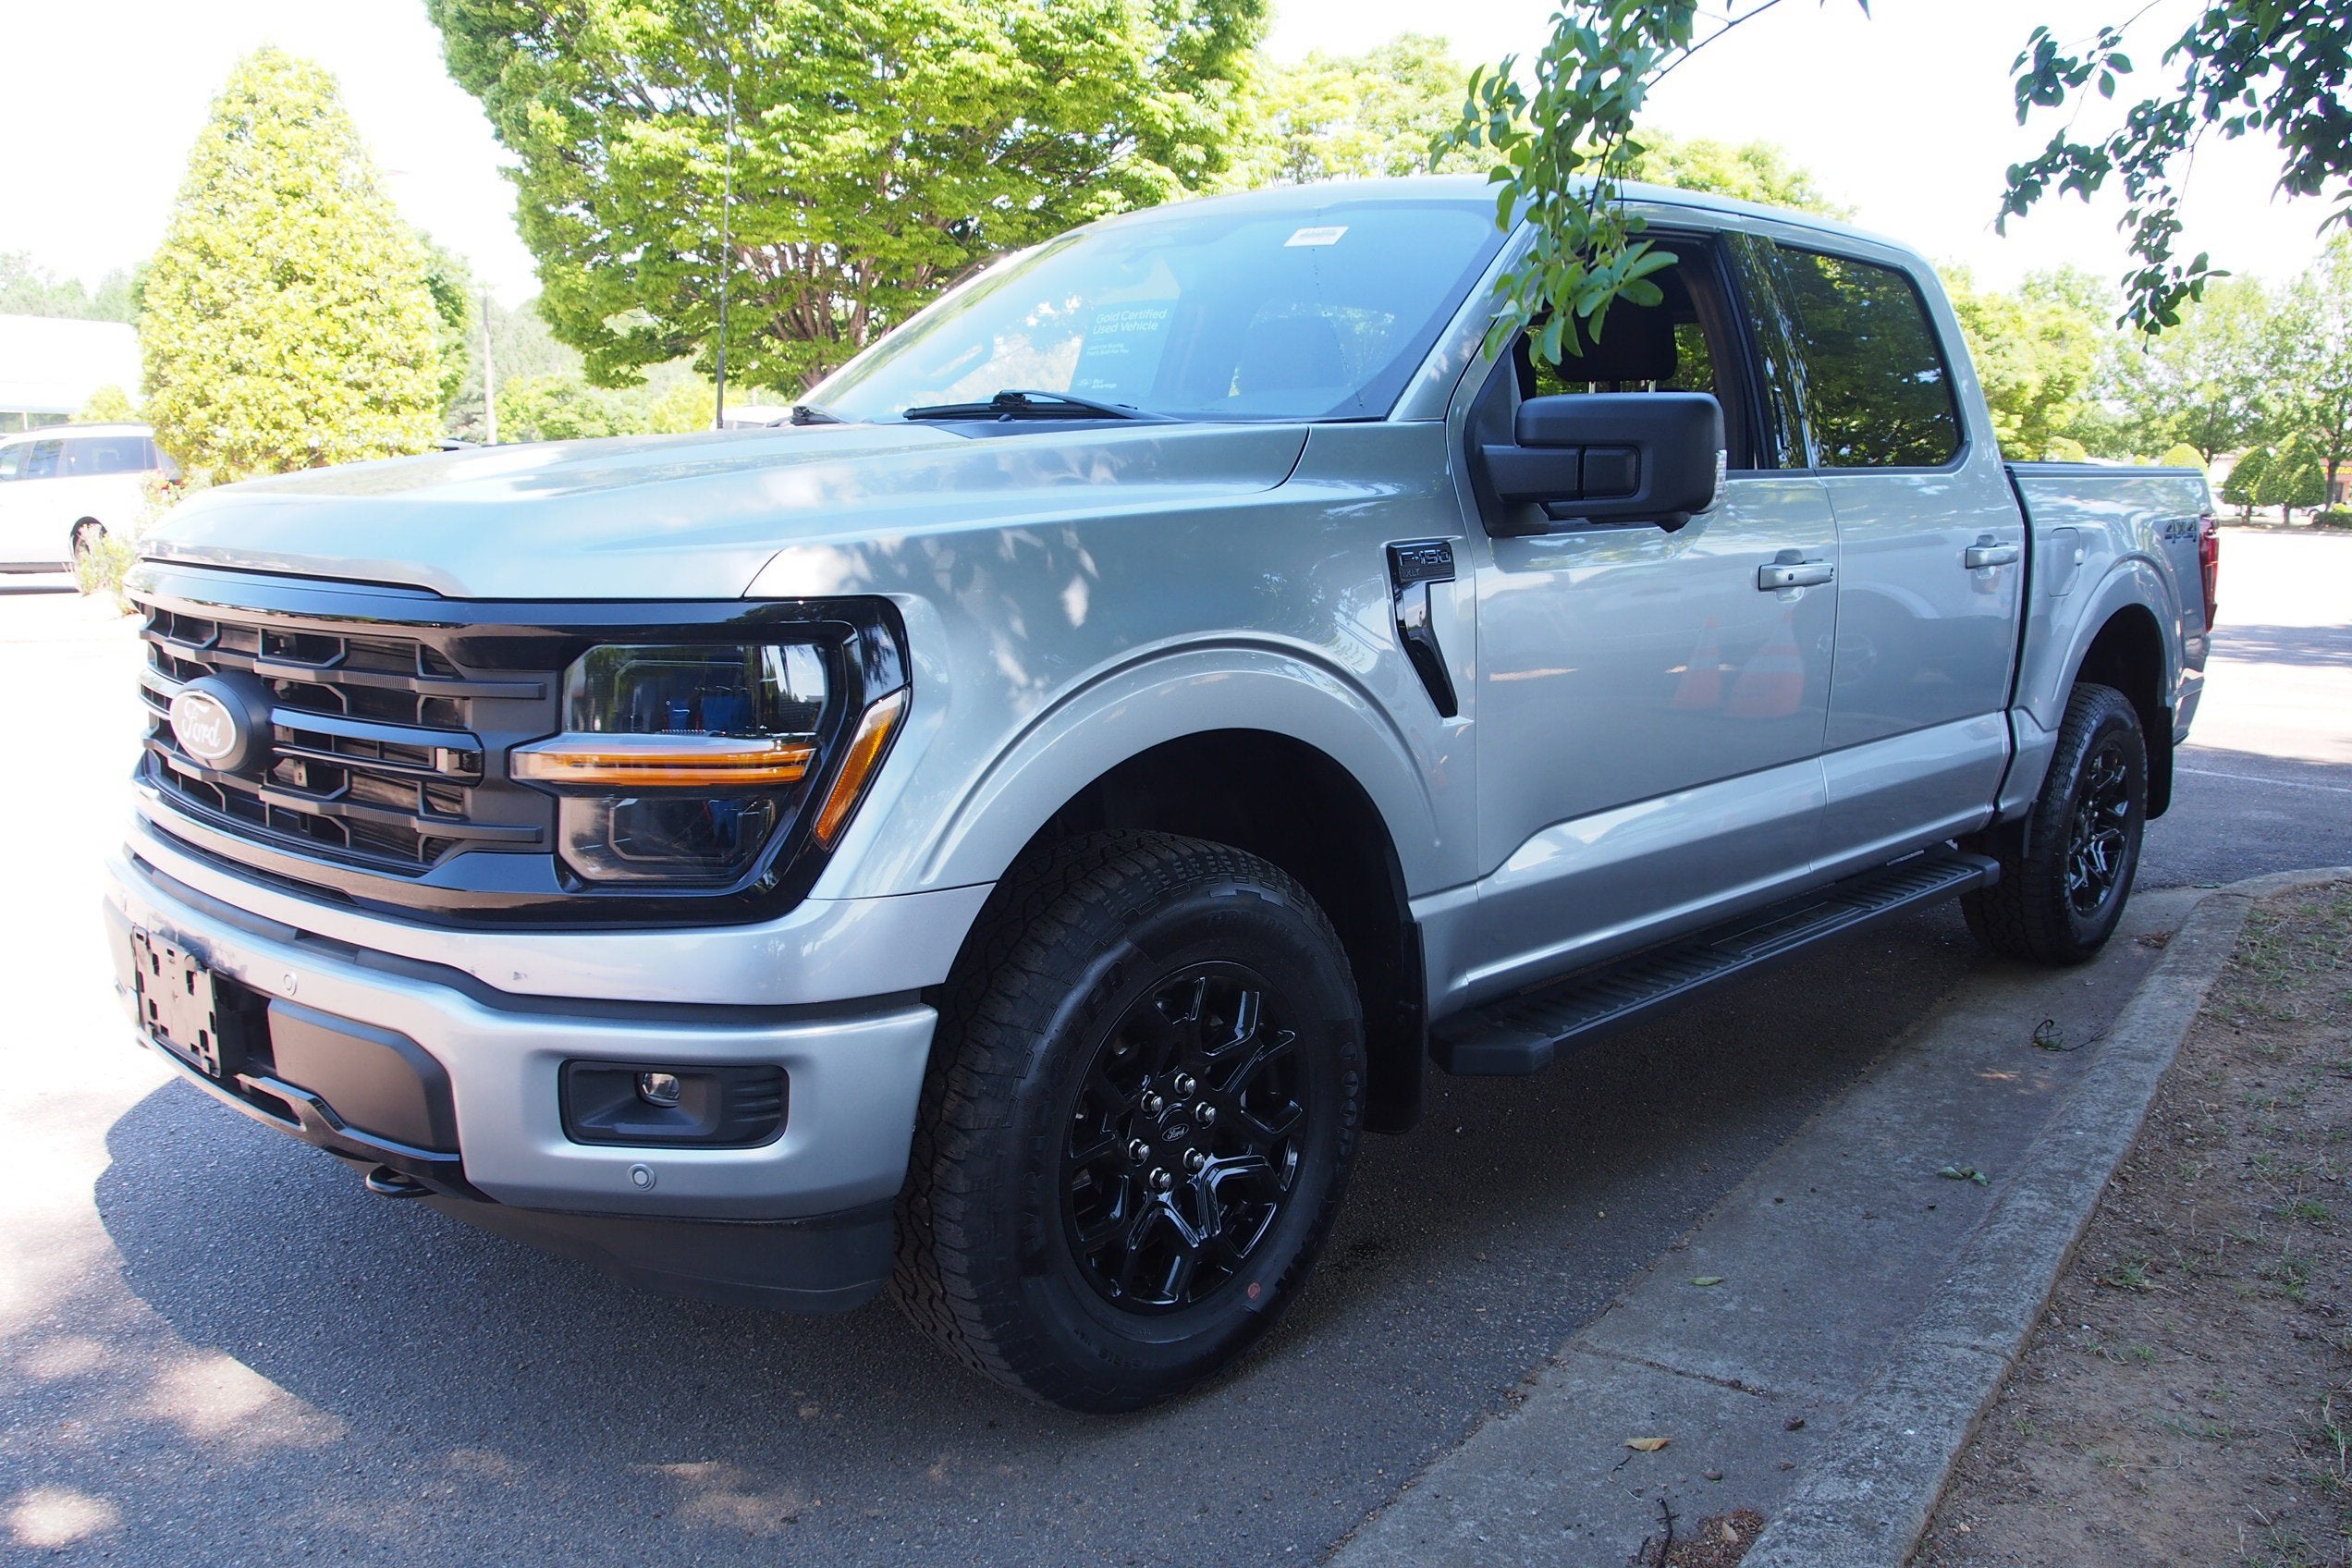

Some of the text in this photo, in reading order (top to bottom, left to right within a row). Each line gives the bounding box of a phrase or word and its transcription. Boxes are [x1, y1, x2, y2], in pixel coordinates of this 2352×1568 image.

[1096, 309, 1168, 324] Gold Certified
[1093, 321, 1158, 335] Used Vehicle
[1399, 549, 1451, 566] F-150
[1405, 568, 1419, 577] XLT
[181, 697, 221, 748] Ford
[1167, 1126, 1185, 1139] Ford
